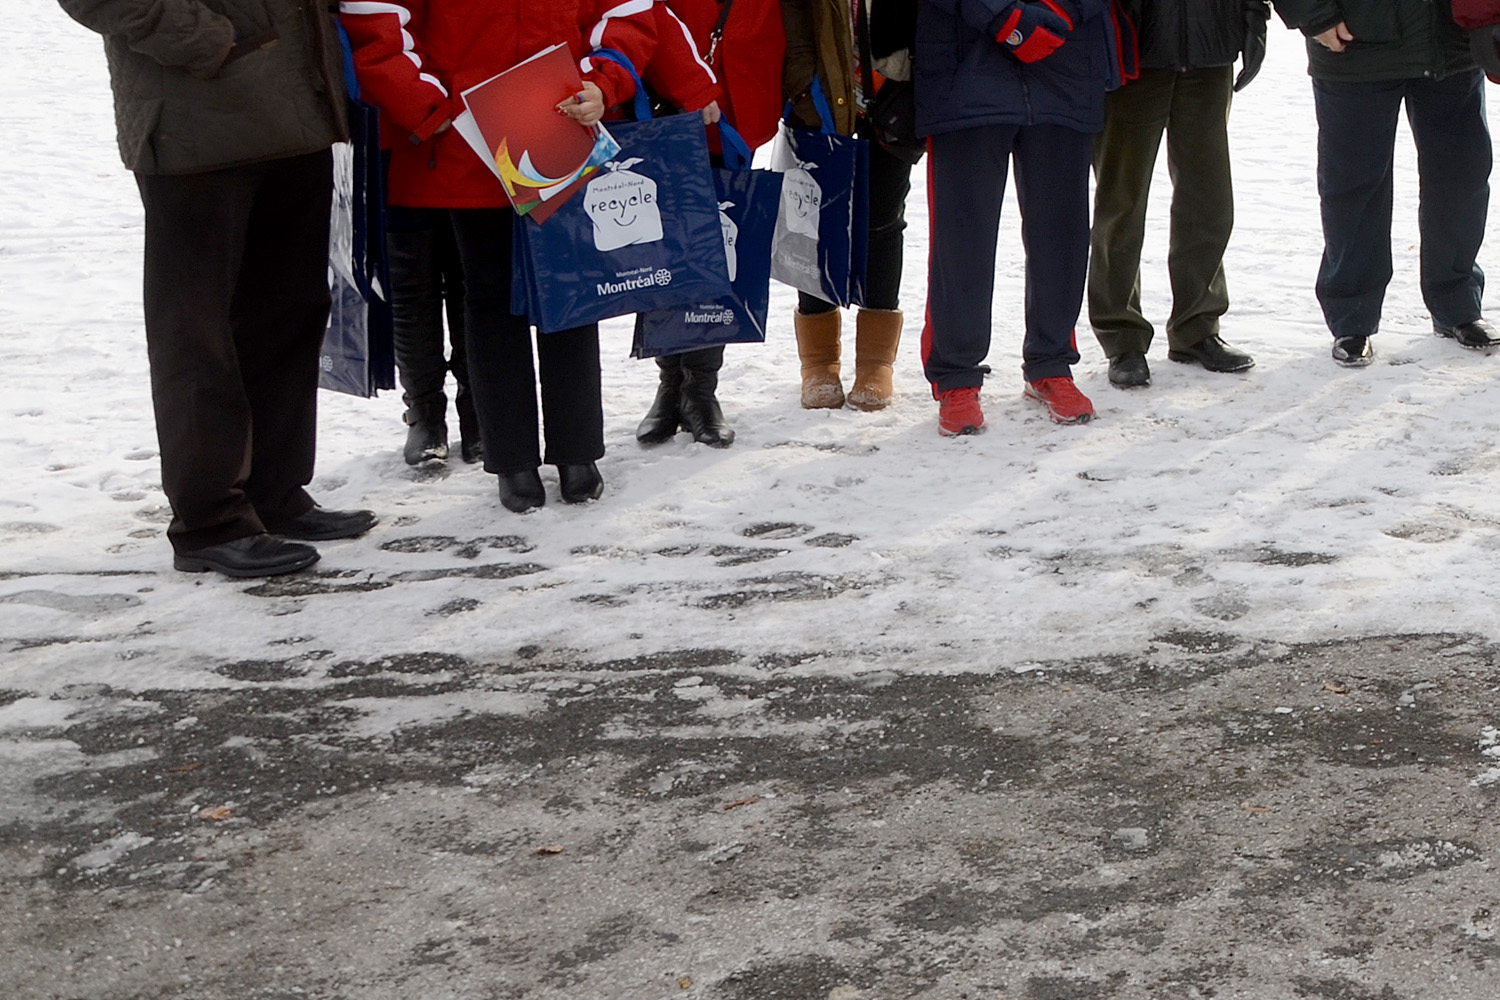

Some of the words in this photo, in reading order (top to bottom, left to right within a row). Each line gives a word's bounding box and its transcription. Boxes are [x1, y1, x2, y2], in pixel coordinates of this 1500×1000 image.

[592, 179, 645, 194] Montréal-Nord
[591, 187, 652, 218] recycle
[596, 273, 656, 297] Montréal
[684, 311, 723, 324] Montréal
